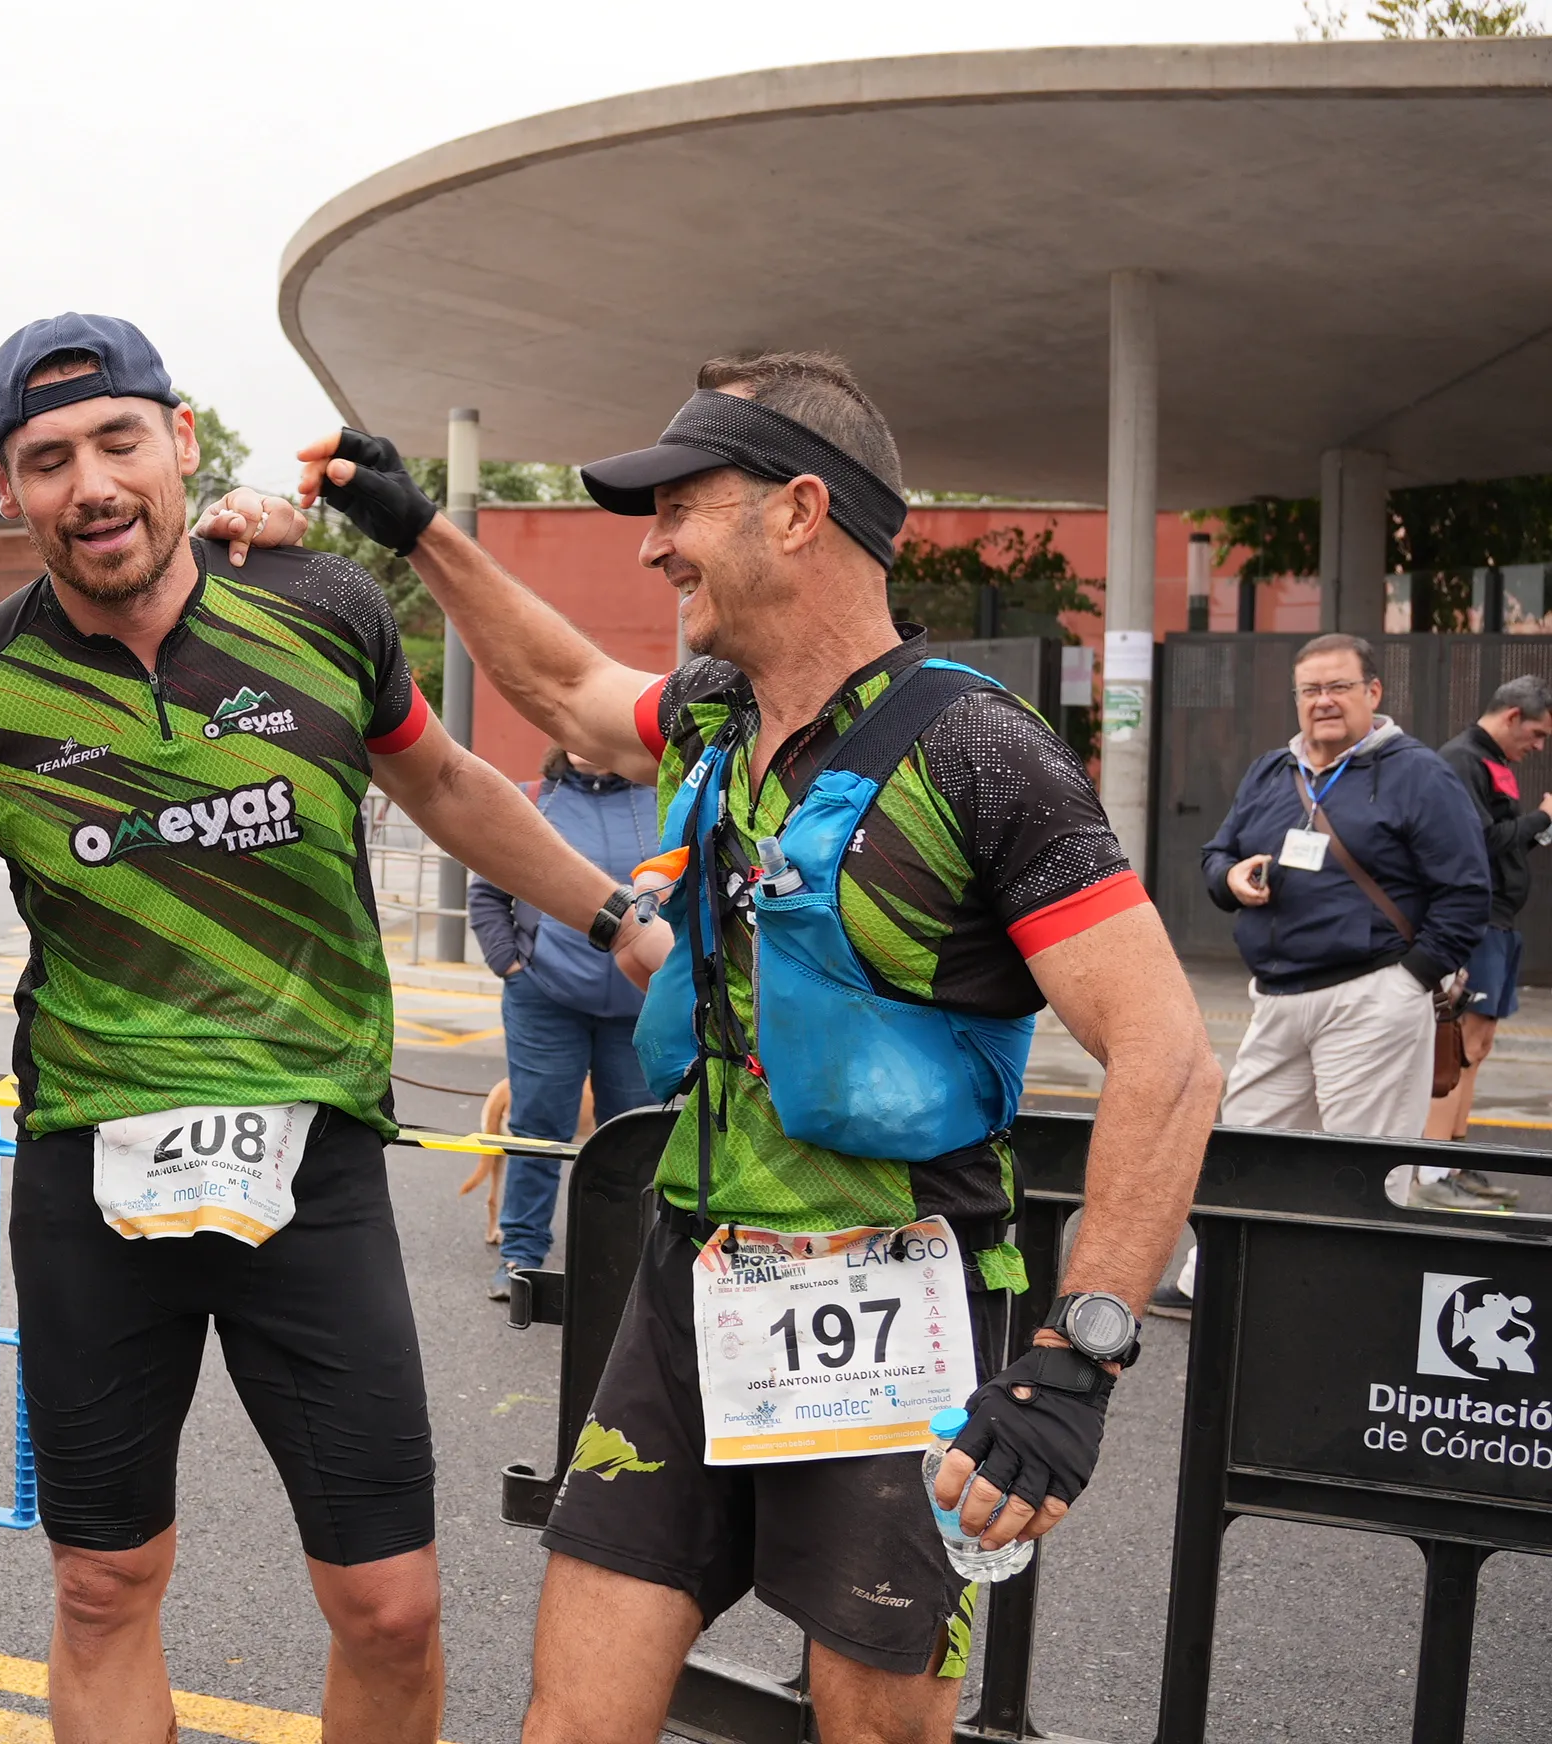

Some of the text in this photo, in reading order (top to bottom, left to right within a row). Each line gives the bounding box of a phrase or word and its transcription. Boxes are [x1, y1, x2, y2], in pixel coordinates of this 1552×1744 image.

[264, 722, 299, 736] TRAIL
[36, 744, 111, 775] TEAMERGY
[222, 818, 299, 852] TRAIL
[146, 1159, 263, 1180] MANUEL LEÓN GONZÁLEZ
[739, 1244, 770, 1254] MONTORO
[716, 1277, 734, 1285] CXM
[733, 1265, 782, 1286] TRAIL
[789, 1278, 839, 1291] RESULTADOS
[769, 1297, 902, 1372] 197
[778, 1374, 831, 1388] ANTONIO
[835, 1369, 881, 1382] GUADIX
[884, 1365, 926, 1378] NÚÑEZ
[927, 1387, 951, 1395] Hospital
[1367, 1382, 1552, 1431] Diputació
[723, 1411, 763, 1424] Fundación
[788, 1439, 816, 1447] bebida
[868, 1429, 921, 1441] consumicion
[1362, 1420, 1552, 1470] de Córdob
[850, 1585, 915, 1608] TEAMERGY
